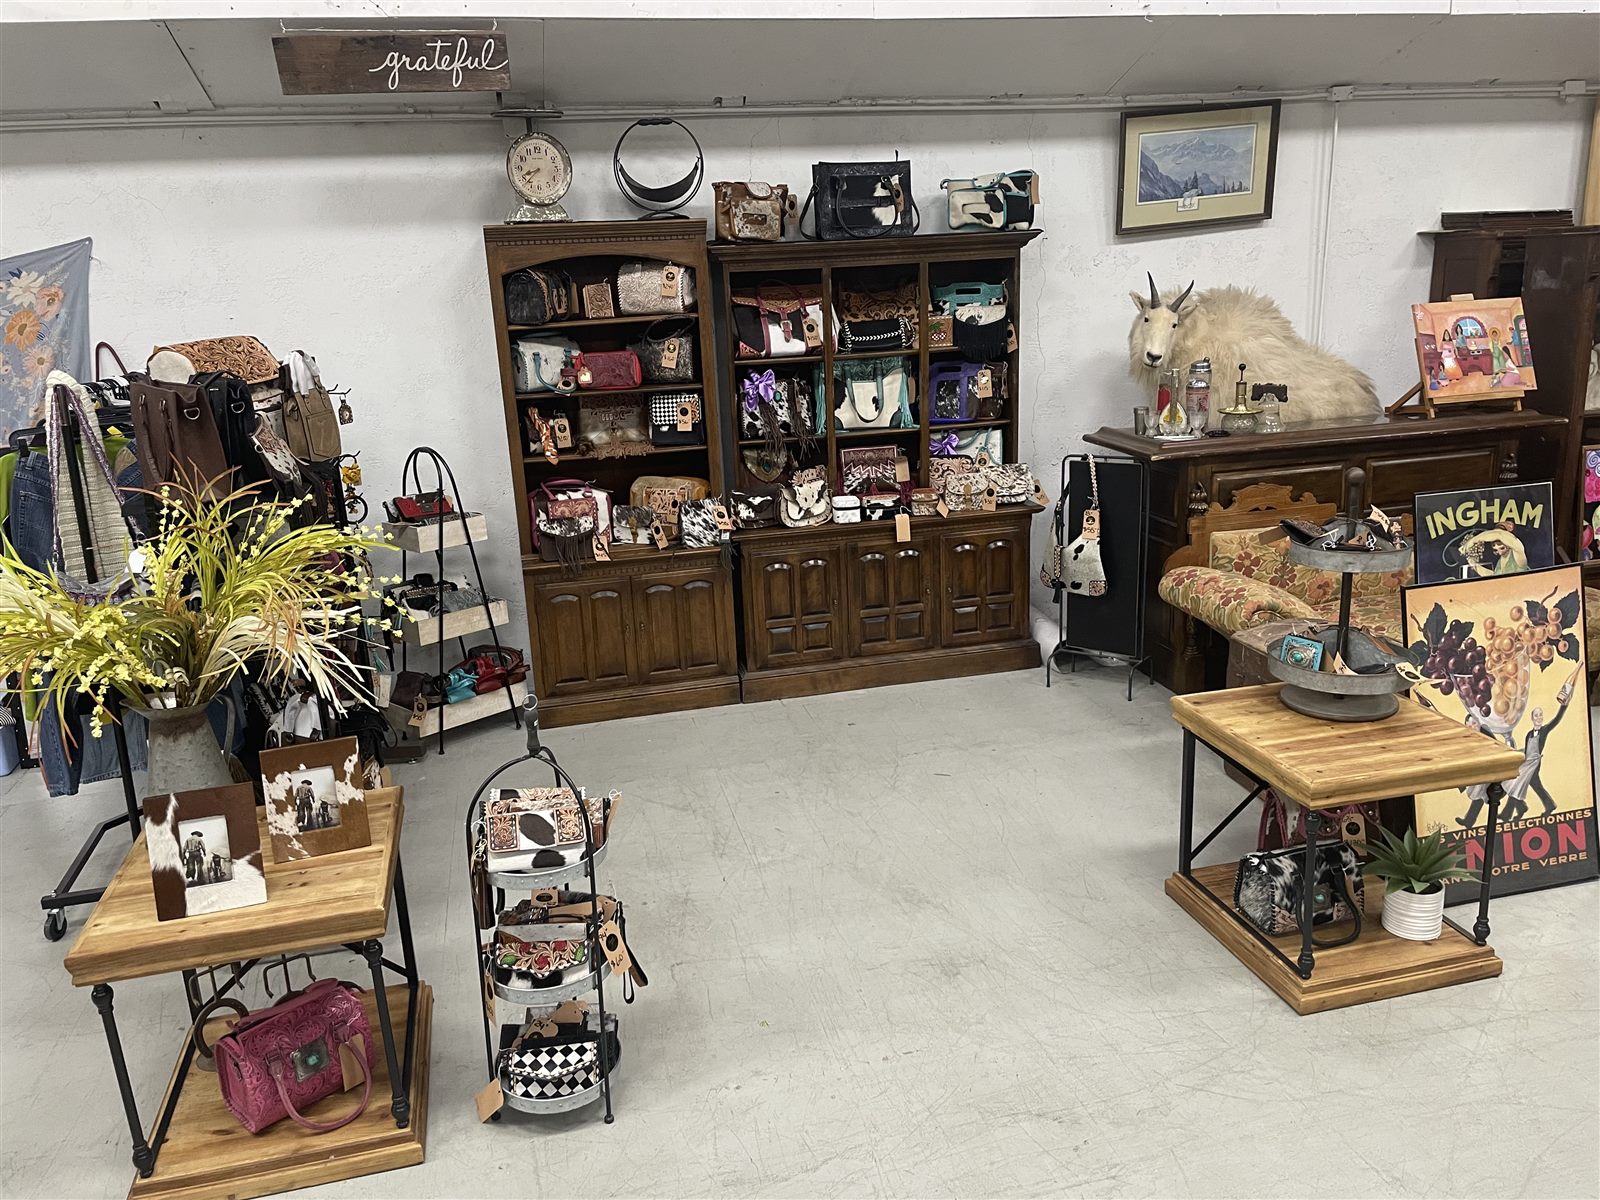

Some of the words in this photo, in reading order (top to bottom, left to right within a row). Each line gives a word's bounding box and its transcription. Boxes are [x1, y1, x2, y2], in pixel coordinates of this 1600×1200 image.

[368, 37, 509, 90] grateful
[519, 155, 527, 163] 10
[526, 148, 532, 156] 11
[550, 156, 556, 164] 2
[1425, 498, 1543, 539] INGHAM
[1452, 828, 1487, 841] VINS
[1447, 820, 1587, 871] NION
[1491, 861, 1531, 877] OTRE
[1539, 851, 1588, 868] VERRE
